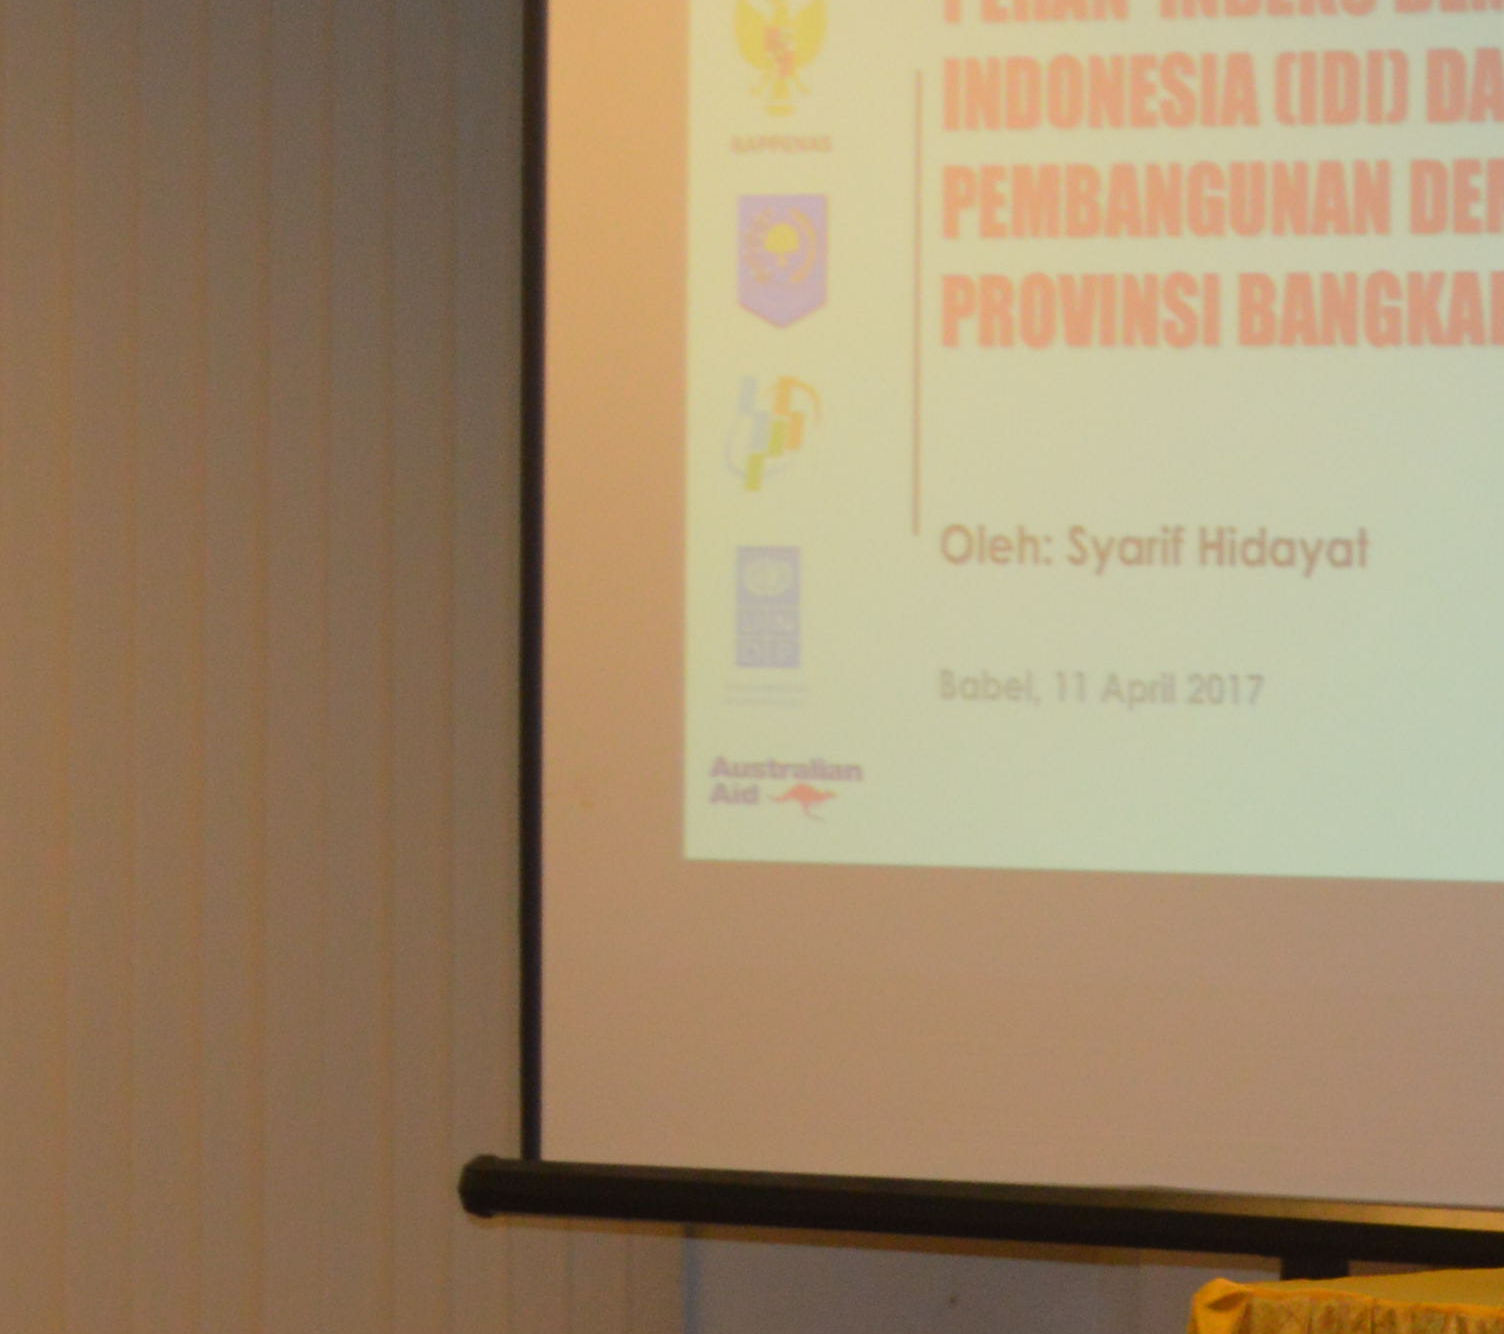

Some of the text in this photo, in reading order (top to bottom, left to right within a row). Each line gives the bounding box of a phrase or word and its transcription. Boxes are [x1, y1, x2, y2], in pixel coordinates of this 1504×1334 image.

[944, 52, 1259, 130] INDONESIA
[1275, 49, 1409, 126] (IDI)
[943, 160, 1391, 238] PEMBANGUNAN
[942, 271, 1220, 349] PROVINSI
[940, 525, 1370, 577] Oleh: Syarif Hidayat
[939, 669, 1265, 709] Babel, 11 April 2017
[708, 756, 864, 781] Australian
[708, 783, 760, 806] Aid
